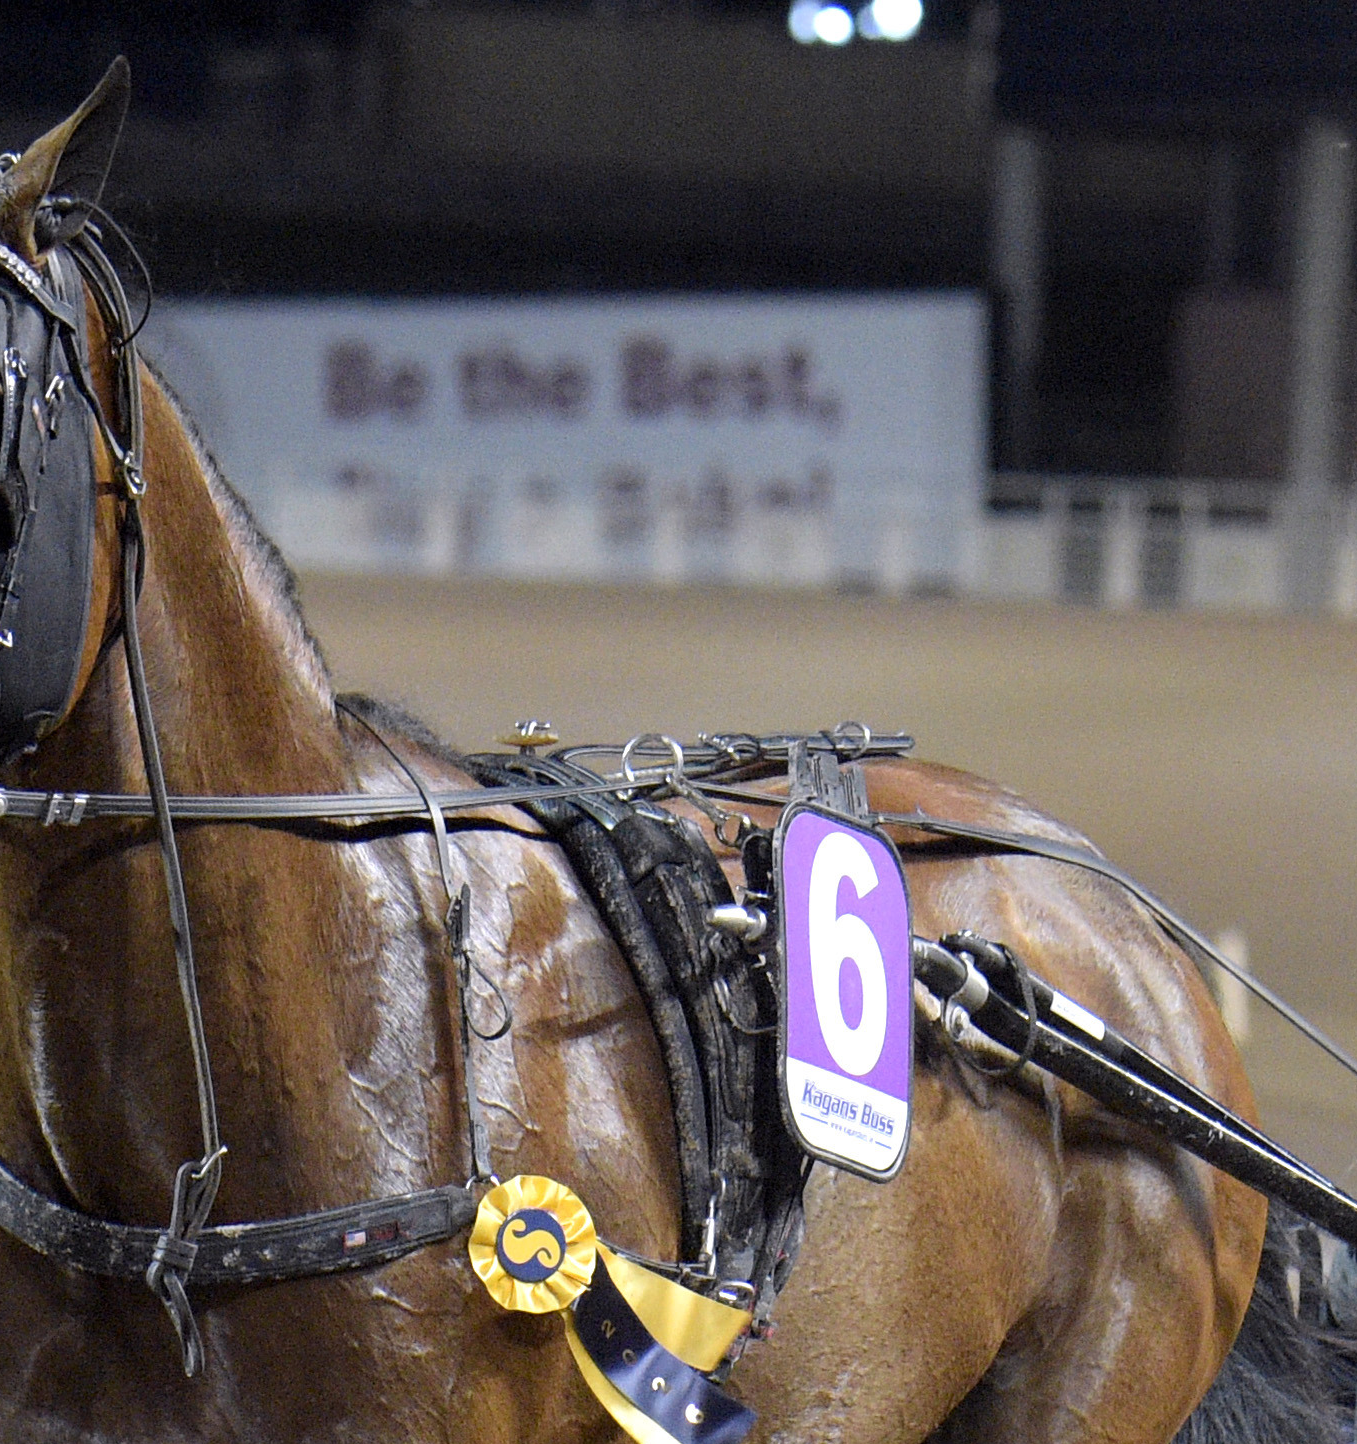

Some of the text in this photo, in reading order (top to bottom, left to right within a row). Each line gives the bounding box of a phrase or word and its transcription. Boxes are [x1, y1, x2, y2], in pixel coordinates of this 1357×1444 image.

[323, 338, 429, 423] Be
[455, 342, 593, 424] the
[809, 831, 887, 1076] 6
[801, 1079, 859, 1120] Kagans
